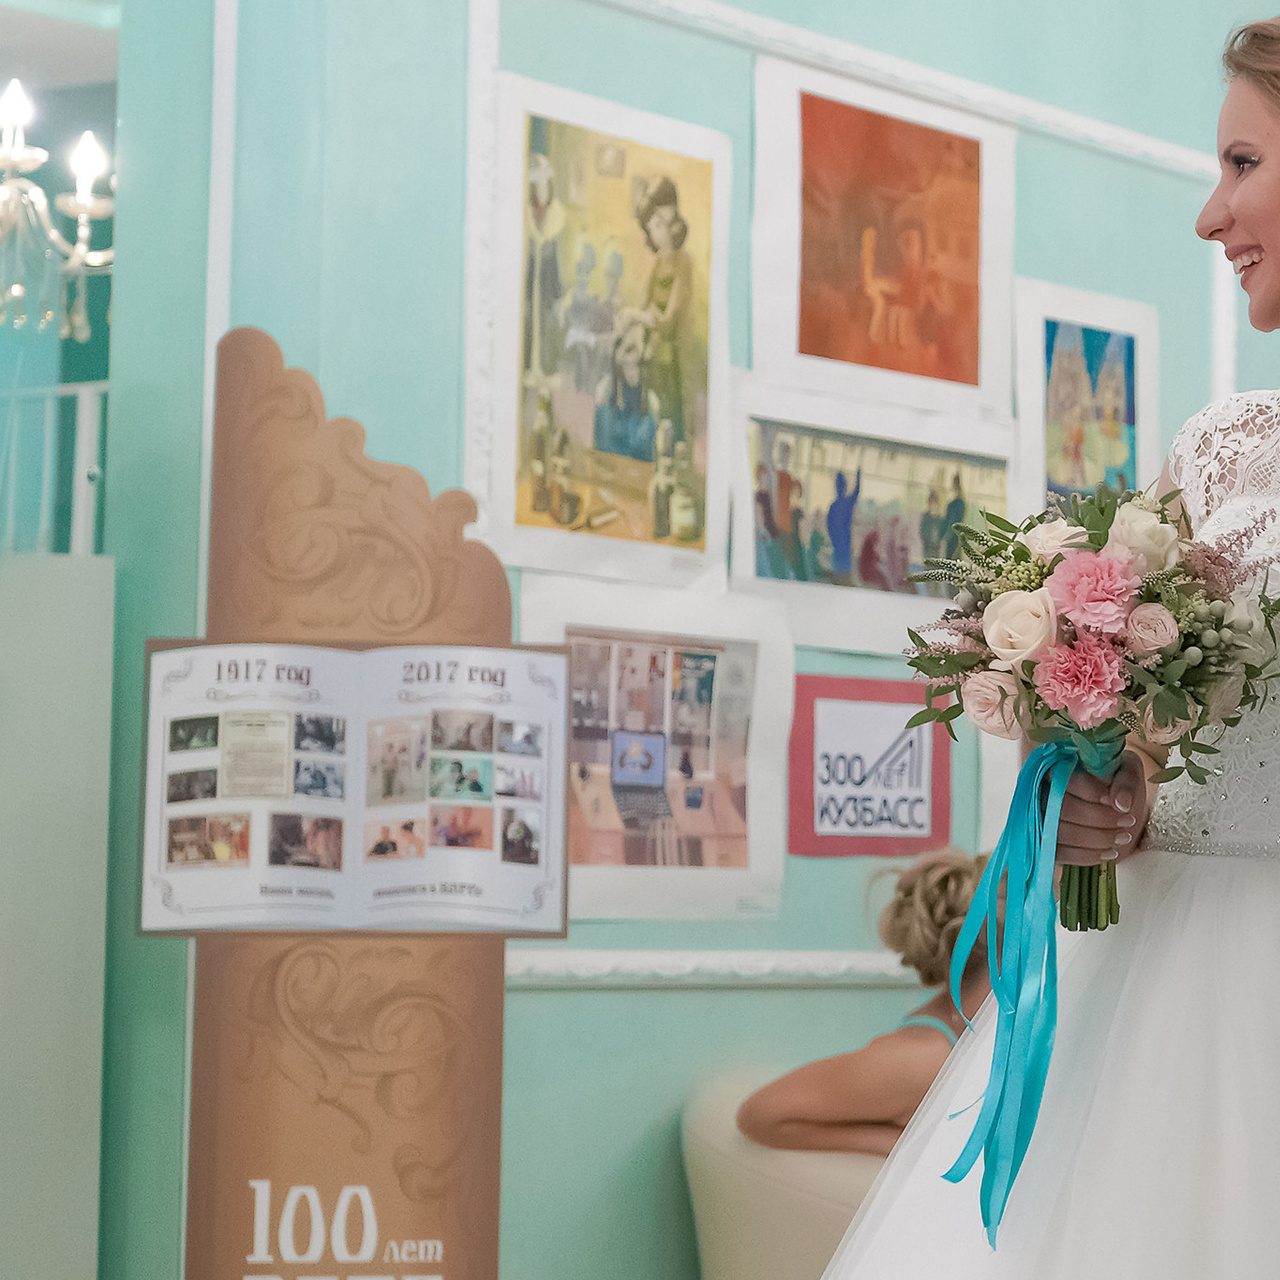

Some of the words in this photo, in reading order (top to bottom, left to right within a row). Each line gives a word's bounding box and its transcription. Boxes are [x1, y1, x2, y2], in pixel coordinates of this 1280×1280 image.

[215, 659, 267, 682] 1917
[402, 661, 458, 684] 2017
[819, 752, 865, 787] 300
[818, 795, 925, 829] КУЗБАСС
[246, 1179, 378, 1264] 100
[383, 1239, 443, 1264] лет
